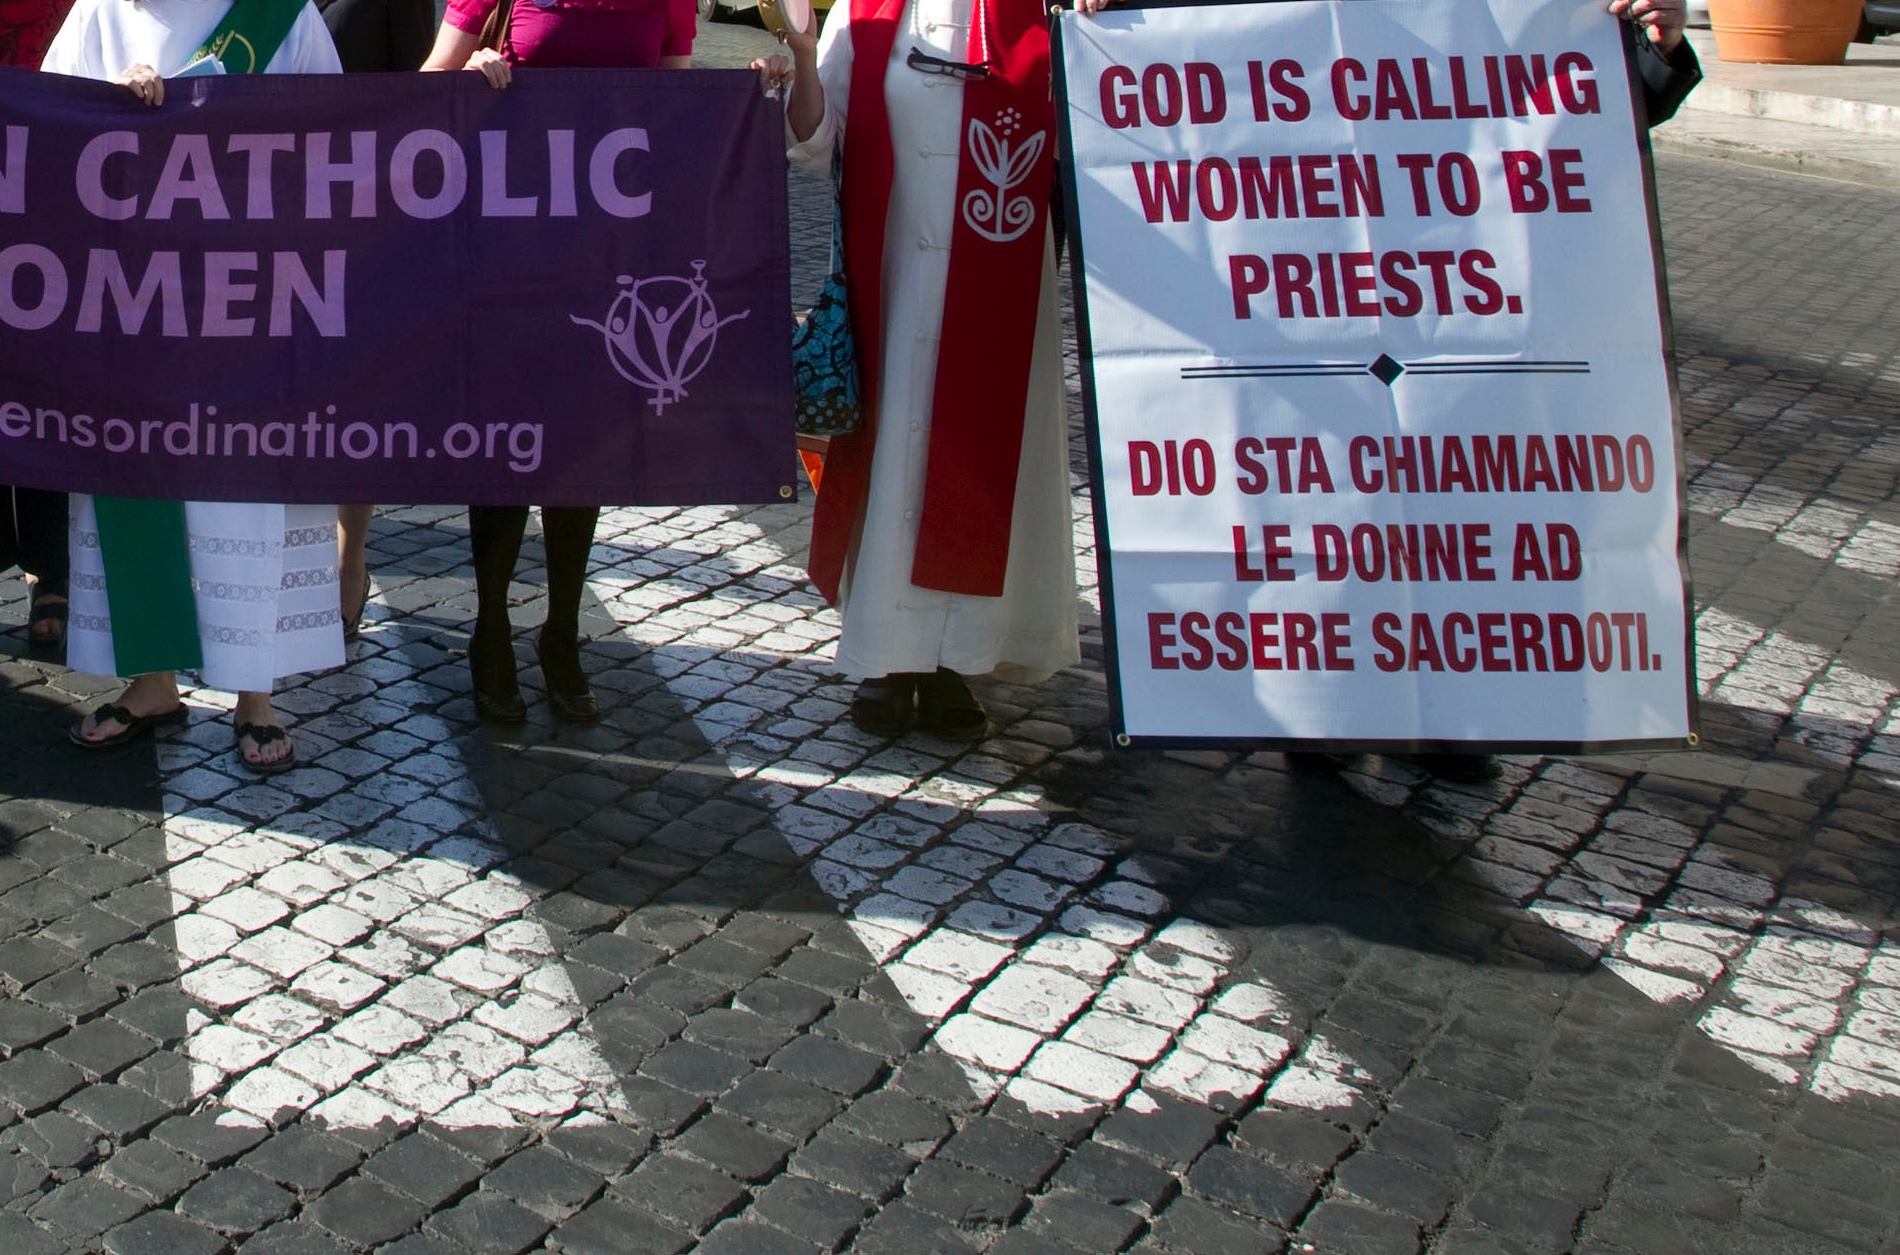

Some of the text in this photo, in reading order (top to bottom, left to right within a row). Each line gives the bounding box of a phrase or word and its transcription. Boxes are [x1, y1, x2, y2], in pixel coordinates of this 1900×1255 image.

[1099, 51, 1602, 129] GOD IS CALLING
[75, 128, 654, 221] CATHOLIC
[1131, 149, 1593, 224] WOMEN TO BE
[1229, 249, 1524, 321] PRIESTS.
[1128, 434, 1655, 497] DIO STA CHIAMANDO
[1232, 522, 1583, 583] LE DONNE AD
[1147, 612, 1662, 673] ESSERE SACERDOTI.
